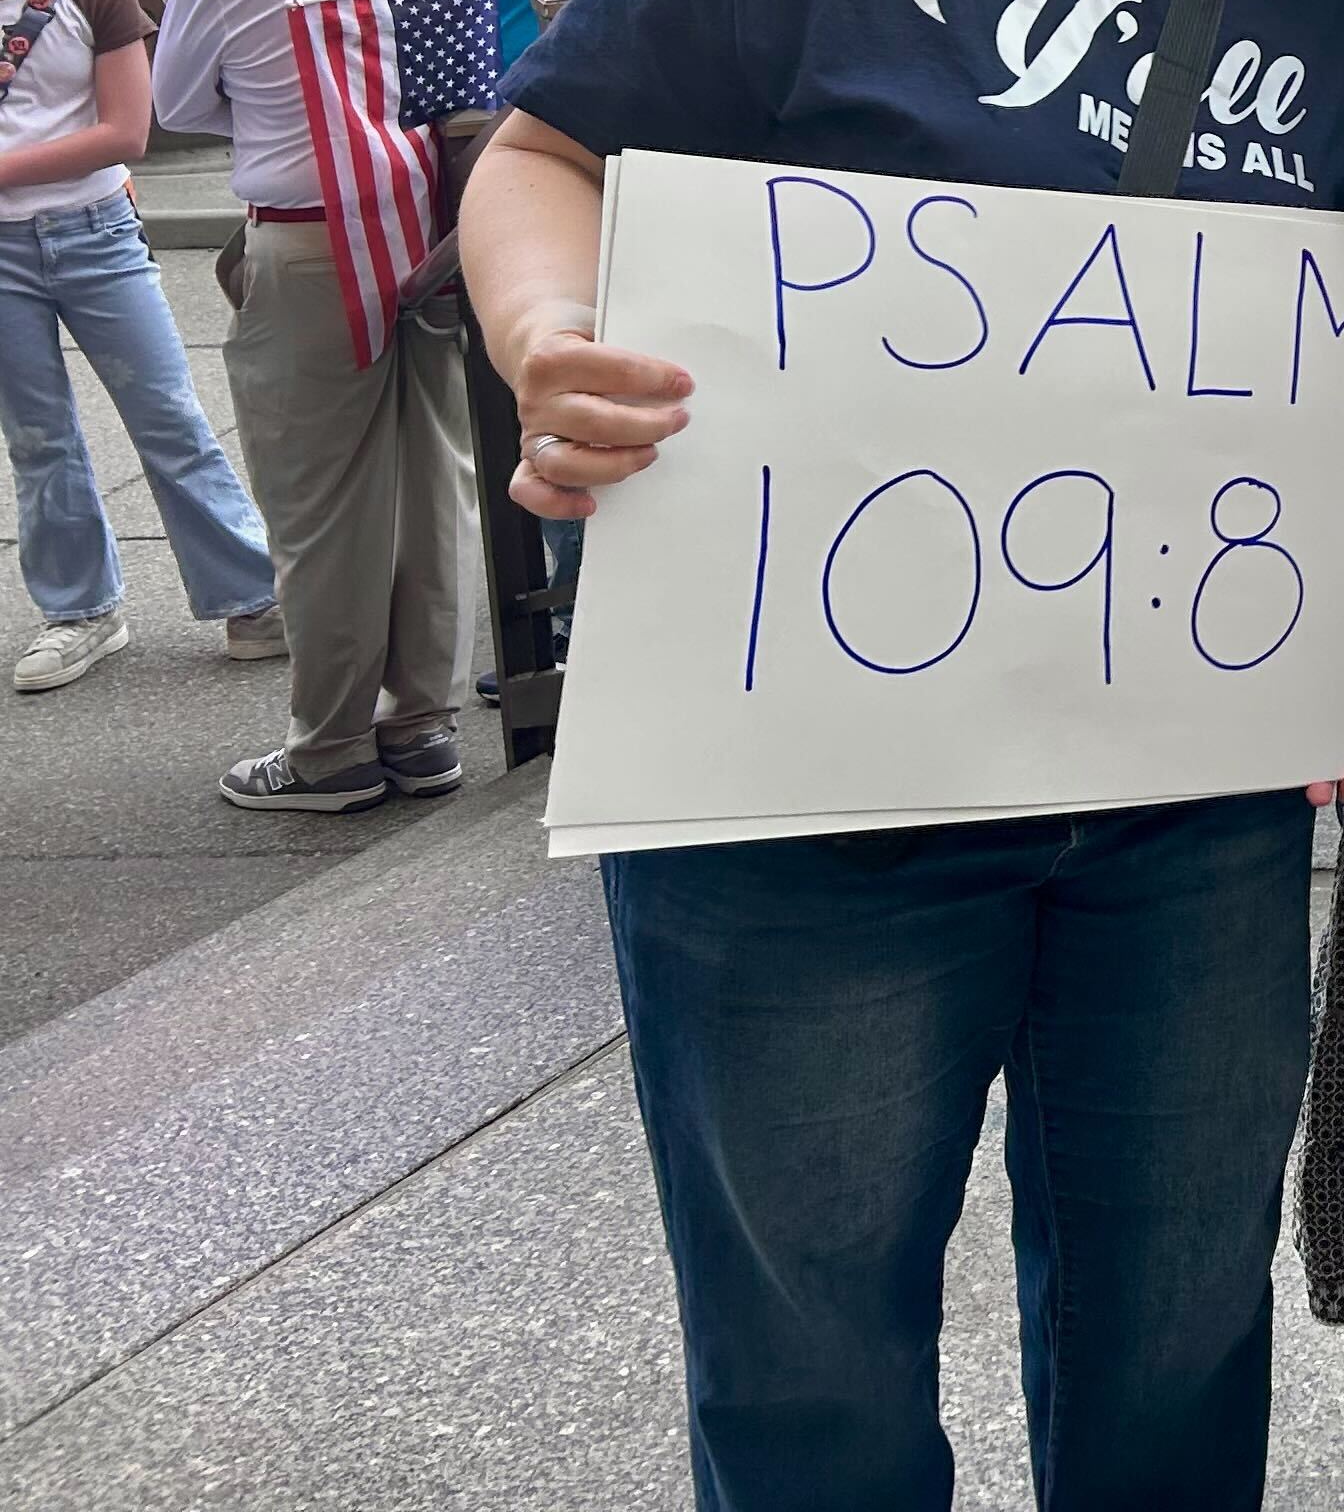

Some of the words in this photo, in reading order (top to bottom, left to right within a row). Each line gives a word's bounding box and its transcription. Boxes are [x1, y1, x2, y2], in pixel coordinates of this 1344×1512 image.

[1078, 93, 1228, 172] MES
[1241, 141, 1316, 193] ALL
[744, 464, 1305, 693] 109:8
